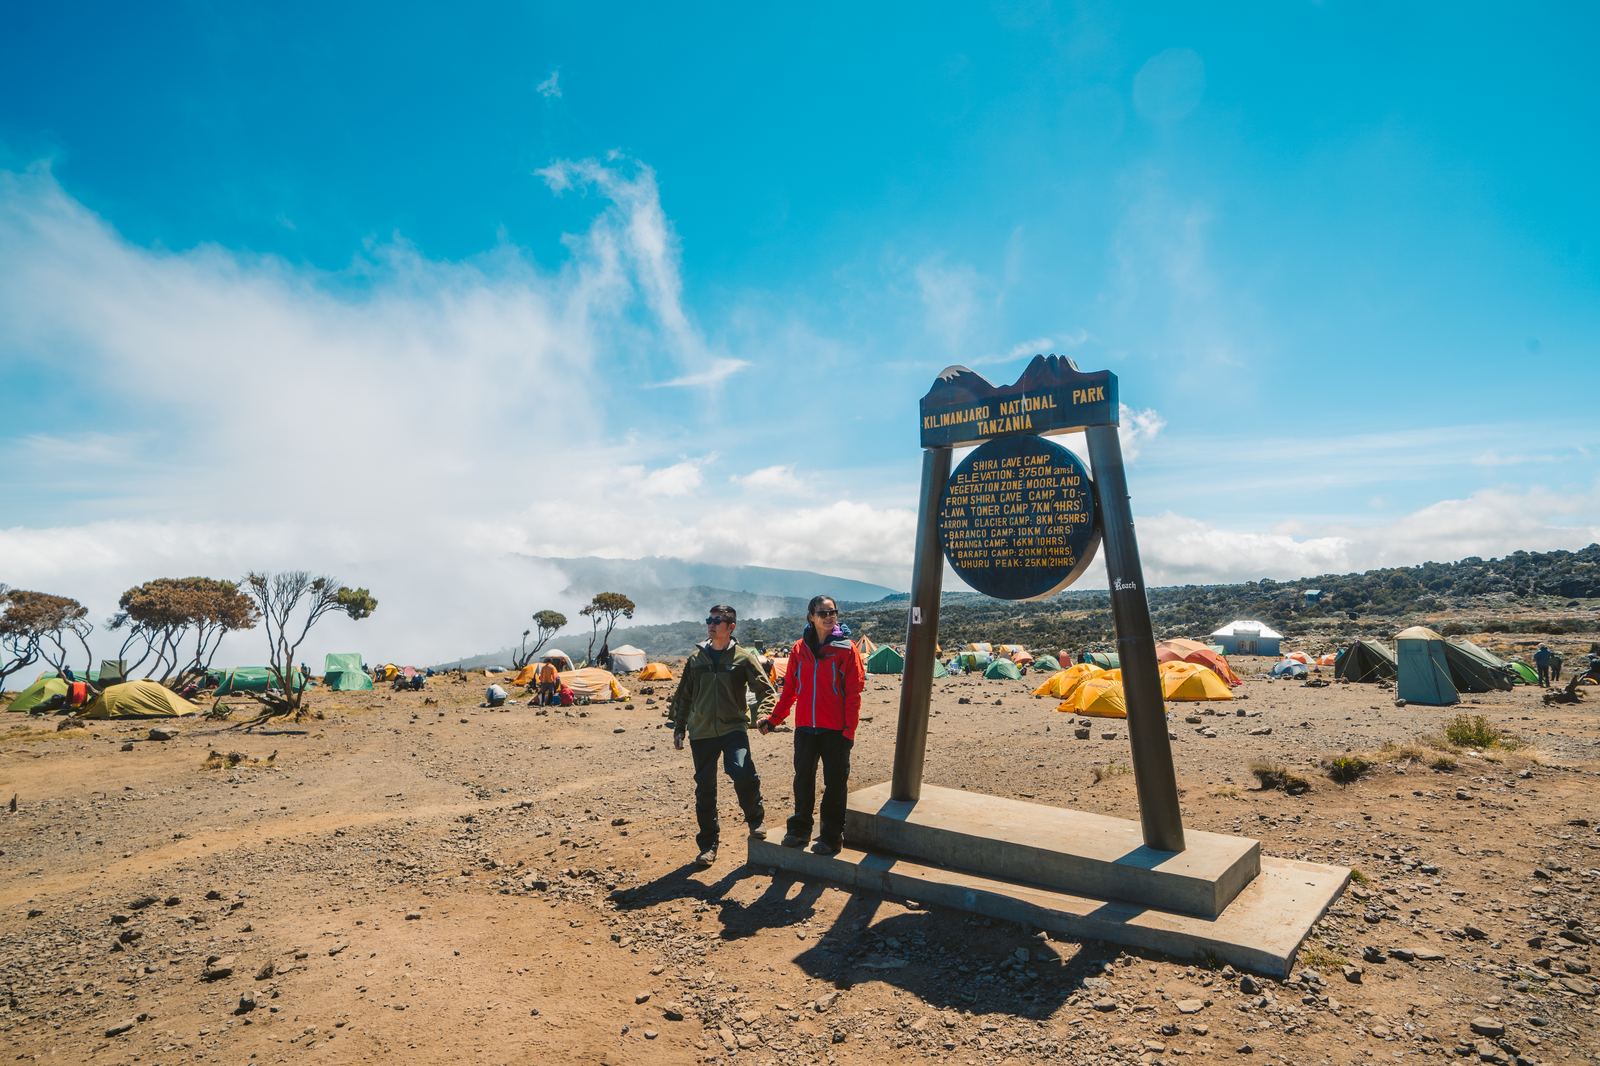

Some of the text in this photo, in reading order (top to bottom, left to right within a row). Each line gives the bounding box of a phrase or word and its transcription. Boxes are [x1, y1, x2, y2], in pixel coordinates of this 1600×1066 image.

[924, 386, 1104, 430] KILIMANJARO NATIONAL PARK
[977, 414, 1032, 435] TANZANIA
[972, 454, 1050, 472] SHIRA CAVE CAMP
[1018, 466, 1052, 478] 3750M
[1054, 464, 1074, 474] amsl
[950, 482, 999, 494] VEGETATION
[1026, 476, 1080, 488] MOORLAND
[946, 496, 968, 506] FROM
[970, 494, 996, 504] SHIRA
[1000, 492, 1022, 502] CAVE
[1028, 490, 1056, 501] CAMP
[944, 507, 966, 518] LAVA
[1004, 504, 1028, 514] CAMP
[944, 519, 968, 529] ARROW
[974, 518, 1008, 528] GLACIER
[950, 540, 982, 549] KARANGA
[958, 550, 988, 558] BARAFU
[961, 560, 990, 568] UHURU
